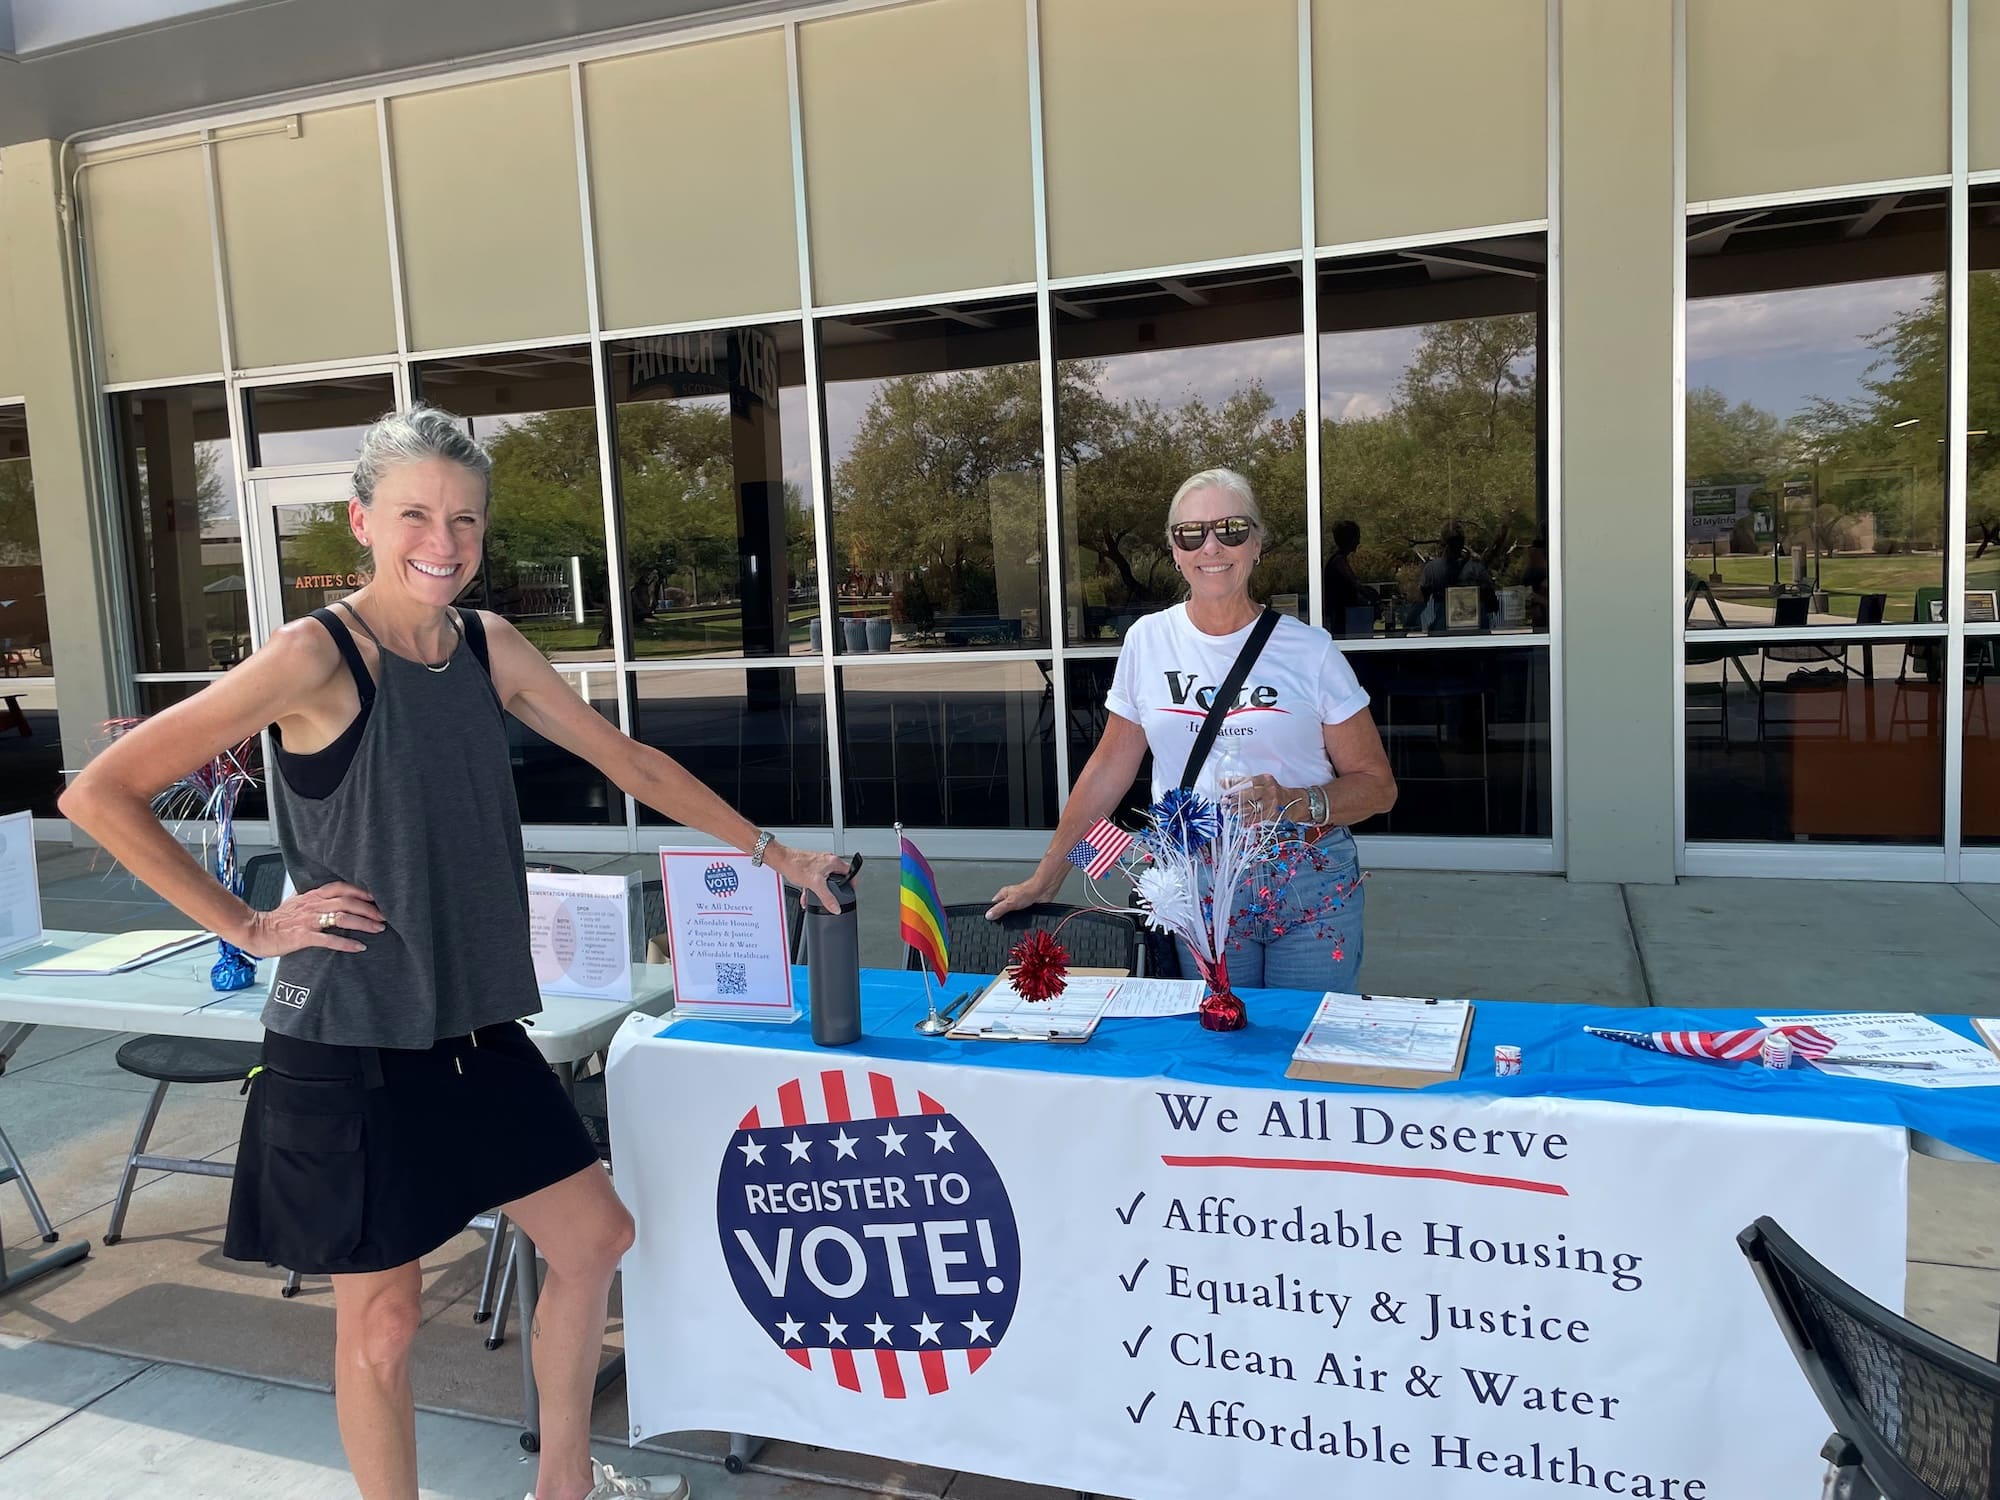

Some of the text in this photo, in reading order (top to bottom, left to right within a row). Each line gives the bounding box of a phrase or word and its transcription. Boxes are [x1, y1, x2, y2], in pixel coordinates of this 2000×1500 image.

[295, 574, 343, 589] ARTIE'S
[1218, 726, 1254, 737] atters
[706, 877, 737, 888] VOTE!
[711, 903, 721, 911] All
[724, 903, 753, 911] Deserve
[694, 930, 722, 938] Equality
[731, 930, 753, 938] Justice
[730, 919, 760, 929] Housing
[733, 951, 770, 959] Healthcare
[275, 984, 307, 1005] CVG
[1156, 1091, 1569, 1161] We All Deserve
[744, 1172, 971, 1215] REGISTER TO
[1162, 1196, 1644, 1293] Affordable Housing
[733, 1219, 1005, 1299] VOTE!
[1166, 1264, 1591, 1344] Equality & Justice
[1170, 1332, 1620, 1421] Clean Air & Water
[1172, 1400, 1707, 1500] Affordable Healthcare
